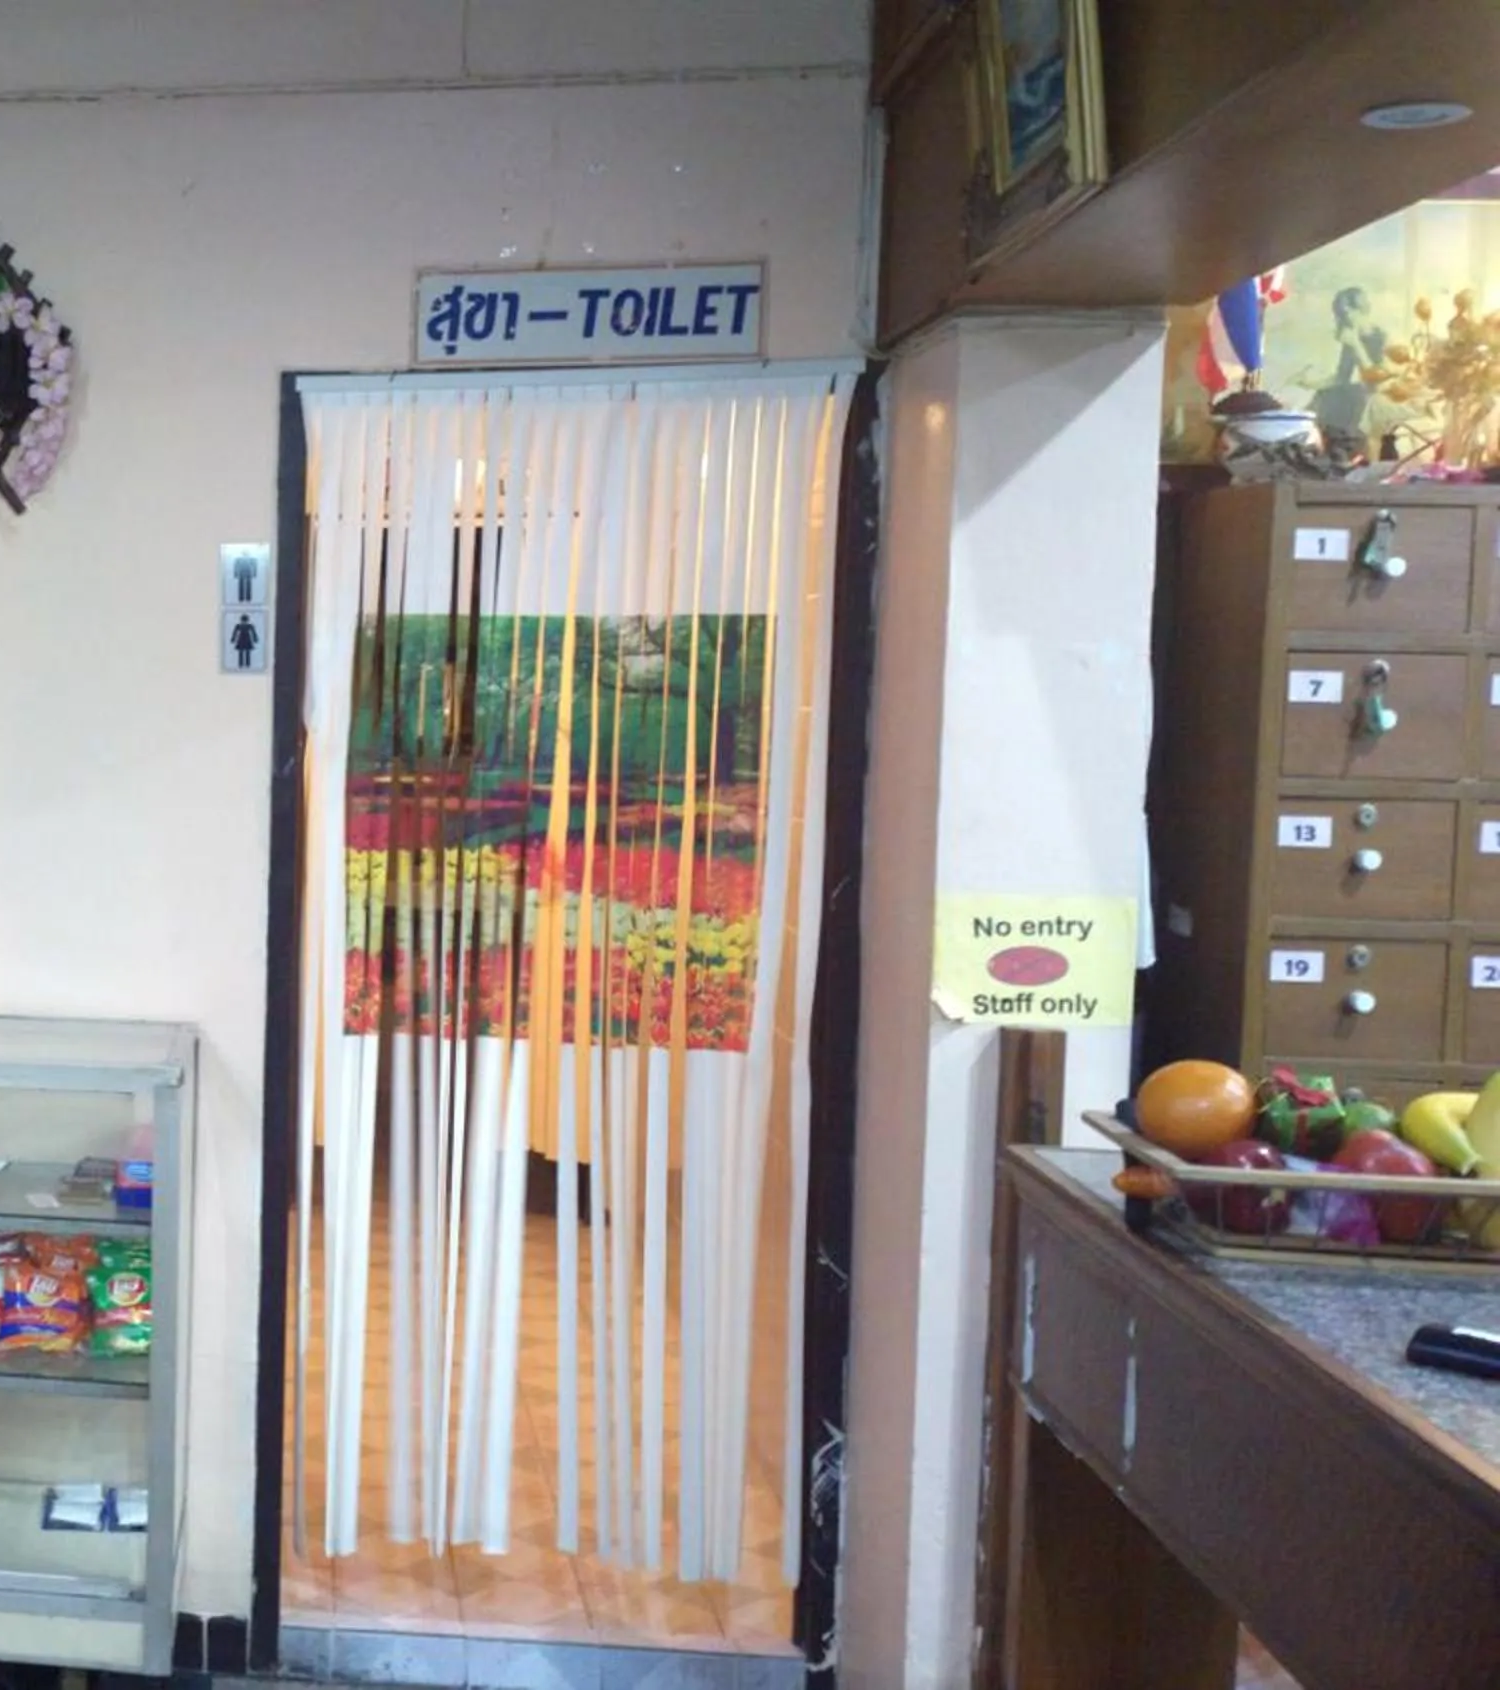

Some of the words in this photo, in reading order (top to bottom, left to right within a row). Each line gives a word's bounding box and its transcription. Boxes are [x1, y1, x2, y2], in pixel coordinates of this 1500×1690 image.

[426, 285, 520, 356] สุขา
[577, 285, 760, 339] TOILET
[1317, 537, 1327, 555] 1
[1308, 679, 1324, 698] 7
[1293, 824, 1317, 842] 13
[972, 916, 1012, 938] No
[1020, 915, 1094, 942] entry
[1284, 959, 1310, 977] 19
[1481, 965, 1500, 982] 2
[972, 993, 1035, 1016] Staff
[1040, 993, 1098, 1019] only
